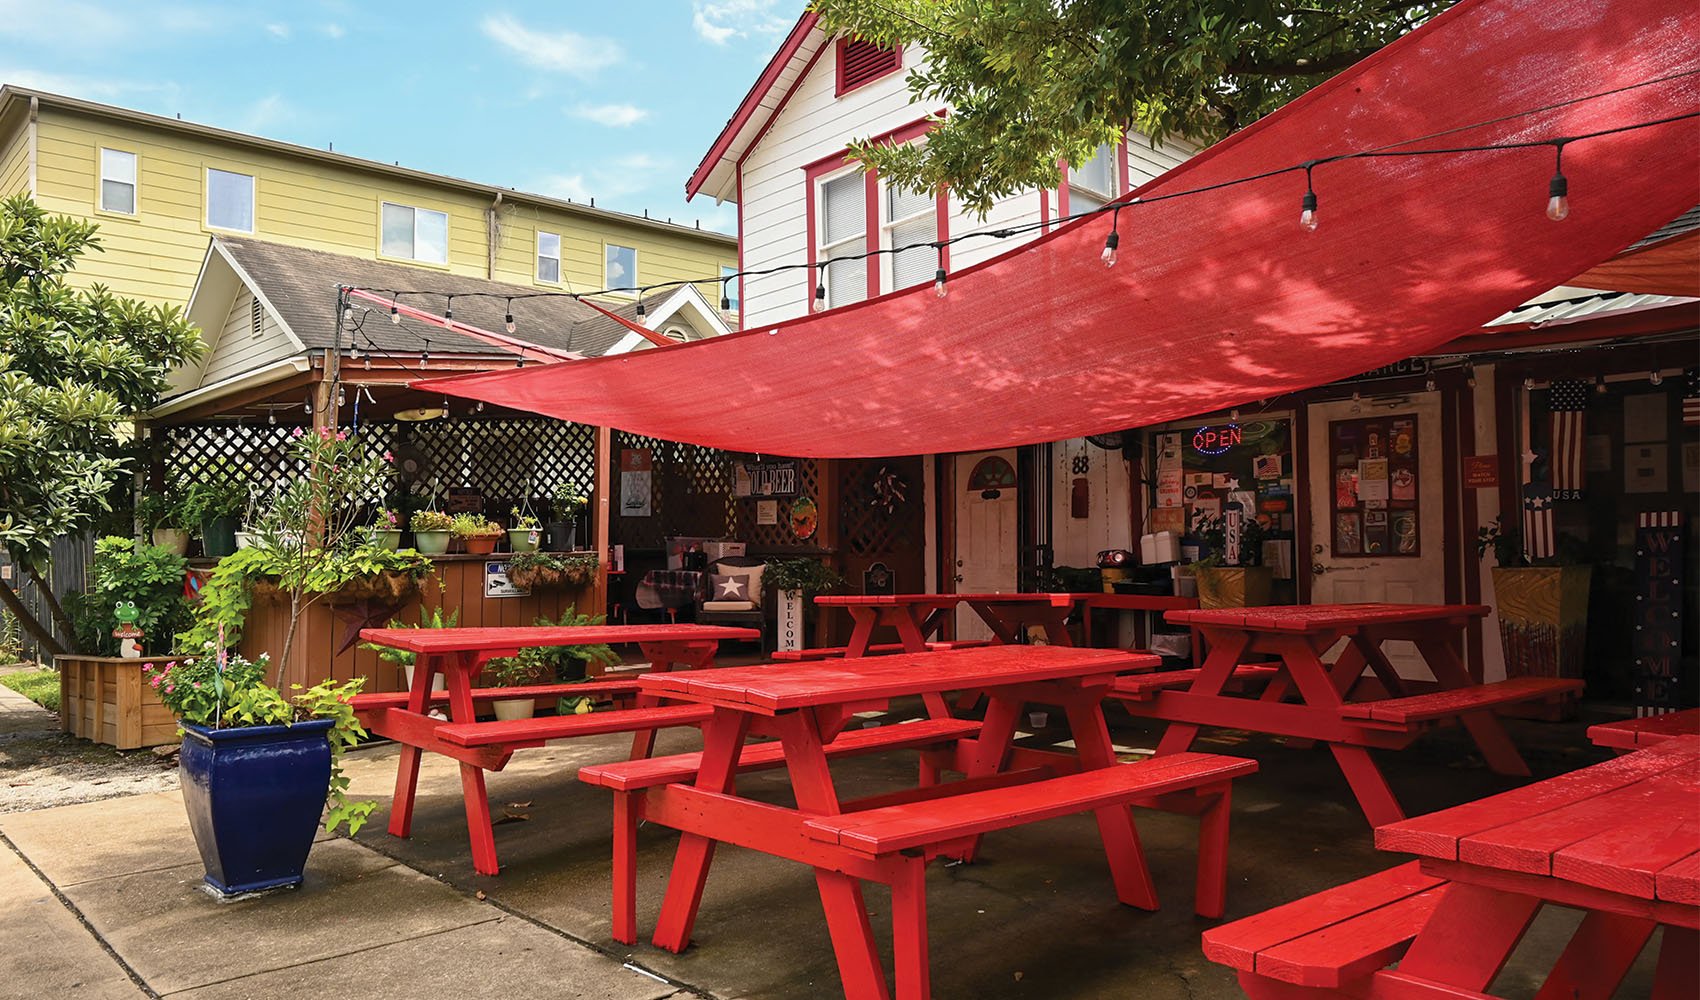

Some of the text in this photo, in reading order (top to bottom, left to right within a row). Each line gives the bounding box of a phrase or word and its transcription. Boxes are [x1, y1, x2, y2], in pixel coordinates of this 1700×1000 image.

[1192, 428, 1242, 450] OPEN
[1072, 455, 1090, 475] 88
[770, 469, 795, 494] BEER
[1552, 490, 1581, 500] USA
[1228, 512, 1237, 560] USA
[785, 590, 794, 651] WELCOM
[1643, 531, 1674, 700] WELCOME
